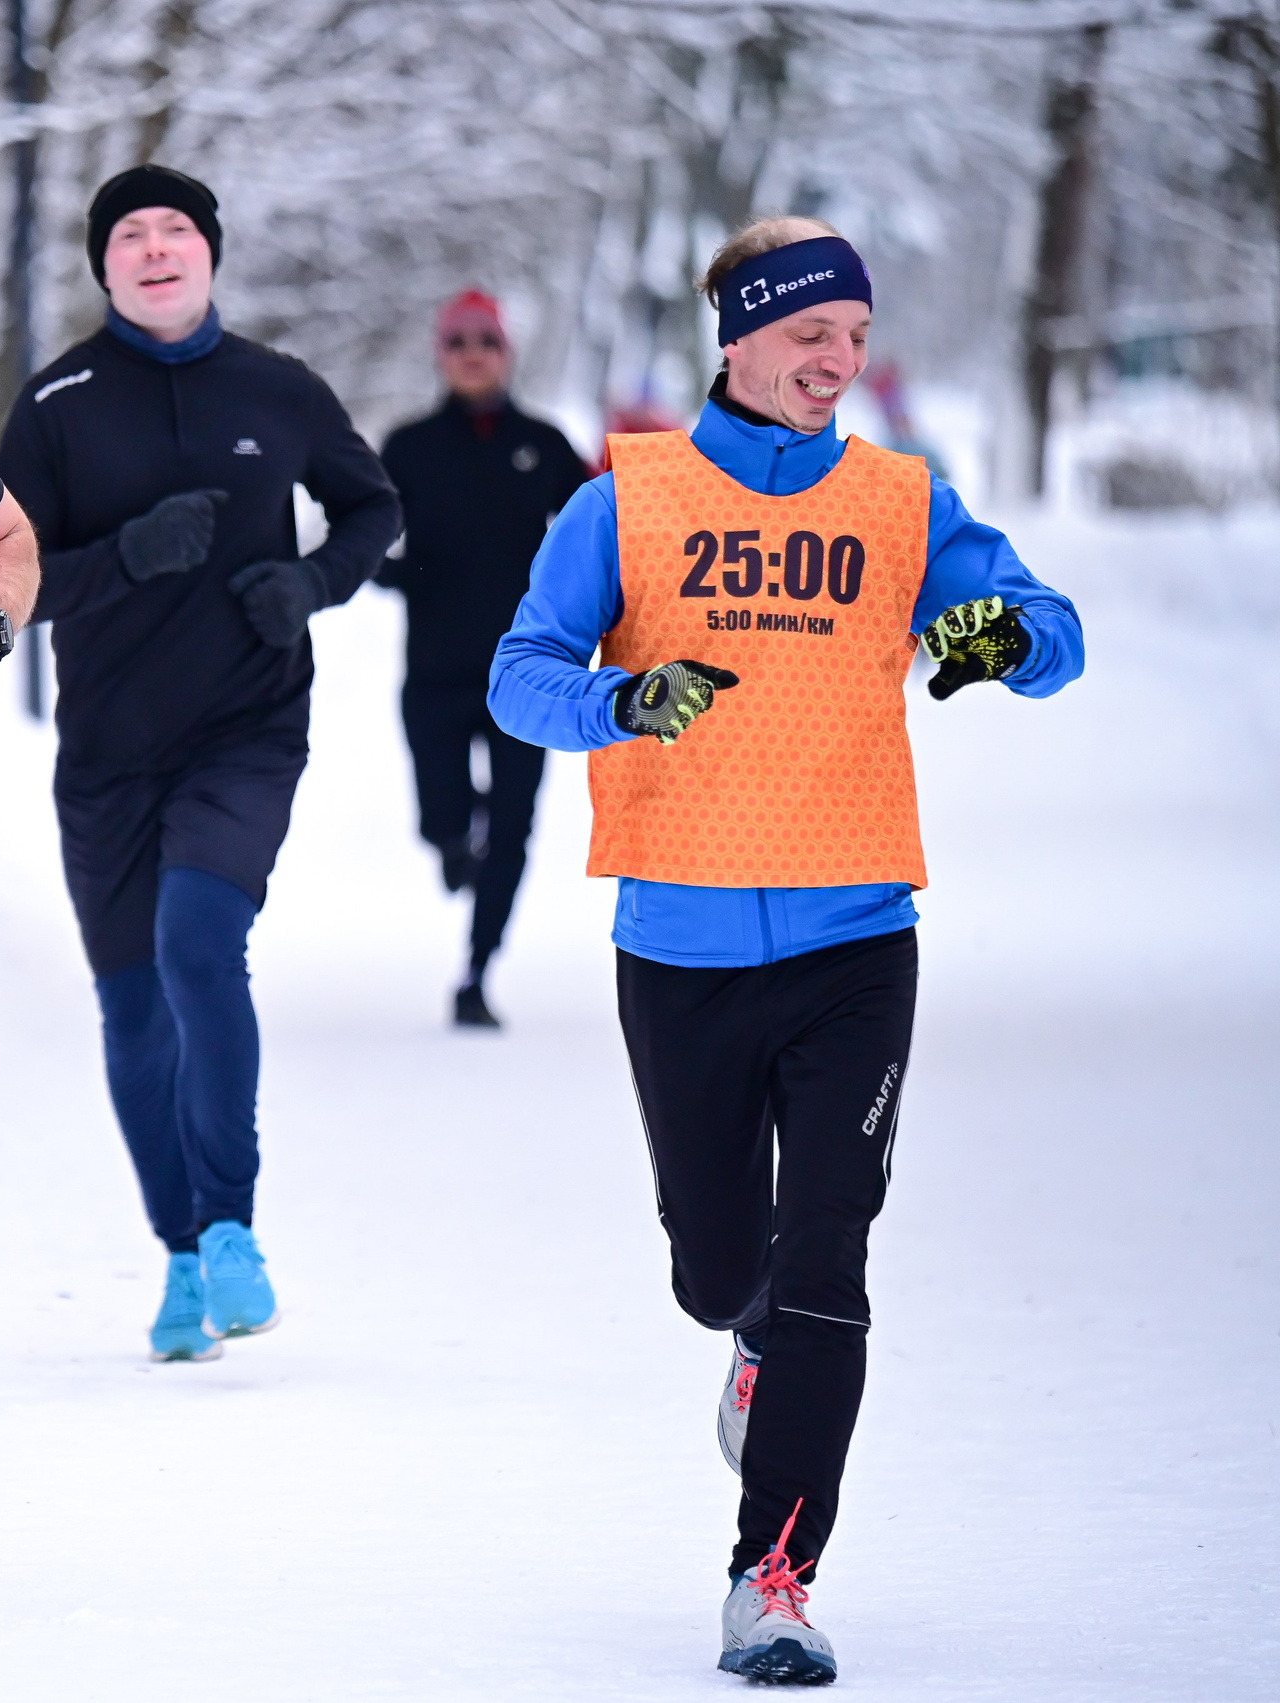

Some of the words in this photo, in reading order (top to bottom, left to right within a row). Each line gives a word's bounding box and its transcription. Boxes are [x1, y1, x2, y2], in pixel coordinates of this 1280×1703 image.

[775, 269, 836, 296] Rostec
[679, 529, 866, 605] 25:00
[706, 609, 752, 631] 5:00
[861, 1072, 894, 1136] CRAFT
